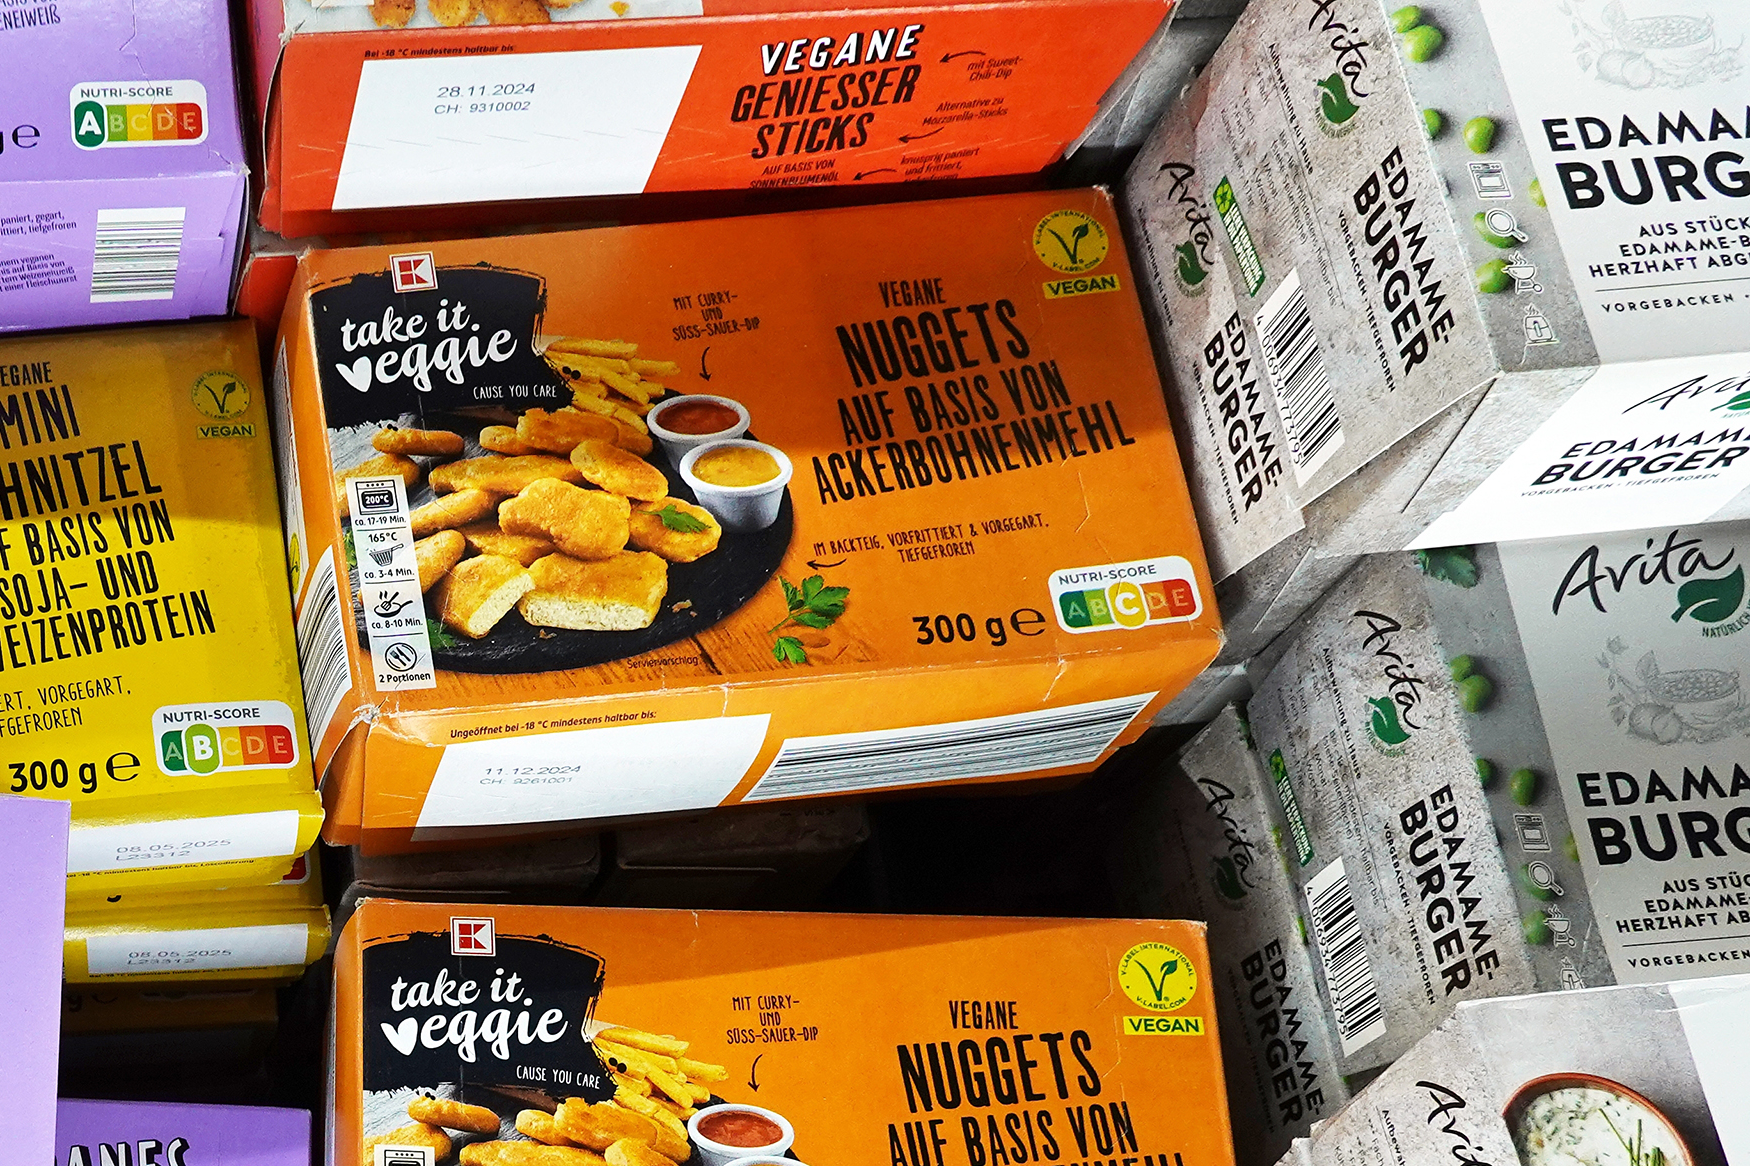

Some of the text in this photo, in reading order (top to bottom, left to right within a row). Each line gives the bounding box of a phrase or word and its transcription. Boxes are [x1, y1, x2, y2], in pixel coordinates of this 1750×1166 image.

[759, 24, 925, 75] VEGANE
[437, 82, 536, 98] 28.11.2024
[731, 65, 922, 123] GENIESSER
[434, 101, 531, 114] CH: 9310002
[752, 113, 874, 160] STICKS
[29, 220, 77, 236] tiefgefroren
[1639, 225, 1676, 238] AUS
[1382, 145, 1456, 344] EDAMAME-
[1353, 170, 1429, 375] BURGER
[1590, 256, 1698, 278] HERZHAFT
[879, 278, 946, 308] VEGANE
[1047, 276, 1116, 295] VEGAN
[436, 299, 470, 331] it
[674, 294, 737, 310] MIT CURRY-
[1601, 294, 1734, 313] VORGEBACKEN
[1227, 310, 1283, 487] EDAMAME-
[1205, 333, 1262, 511] BURGER
[22, 510, 109, 566] BASIS
[112, 499, 175, 550] VON
[100, 550, 159, 598] UND
[1552, 529, 1735, 614] Avita
[913, 615, 1006, 646] 300 g
[388, 671, 431, 684] Portionen
[450, 725, 502, 738] Ungeöffnet
[505, 724, 518, 732] bei
[521, 722, 534, 730] -18
[551, 716, 602, 727] mindestens
[605, 712, 638, 723] haltbar
[8, 760, 98, 793] 300 g
[486, 766, 581, 775] 11.12.2024
[116, 851, 190, 861] L23312
[117, 839, 231, 853] 08.05.2025
[1616, 914, 1717, 934] HERZHAFT
[390, 968, 480, 1011] take
[1128, 1017, 1199, 1033] VEGAN
[897, 1031, 1101, 1113] NUGGETS
[1067, 1102, 1139, 1157] VON
